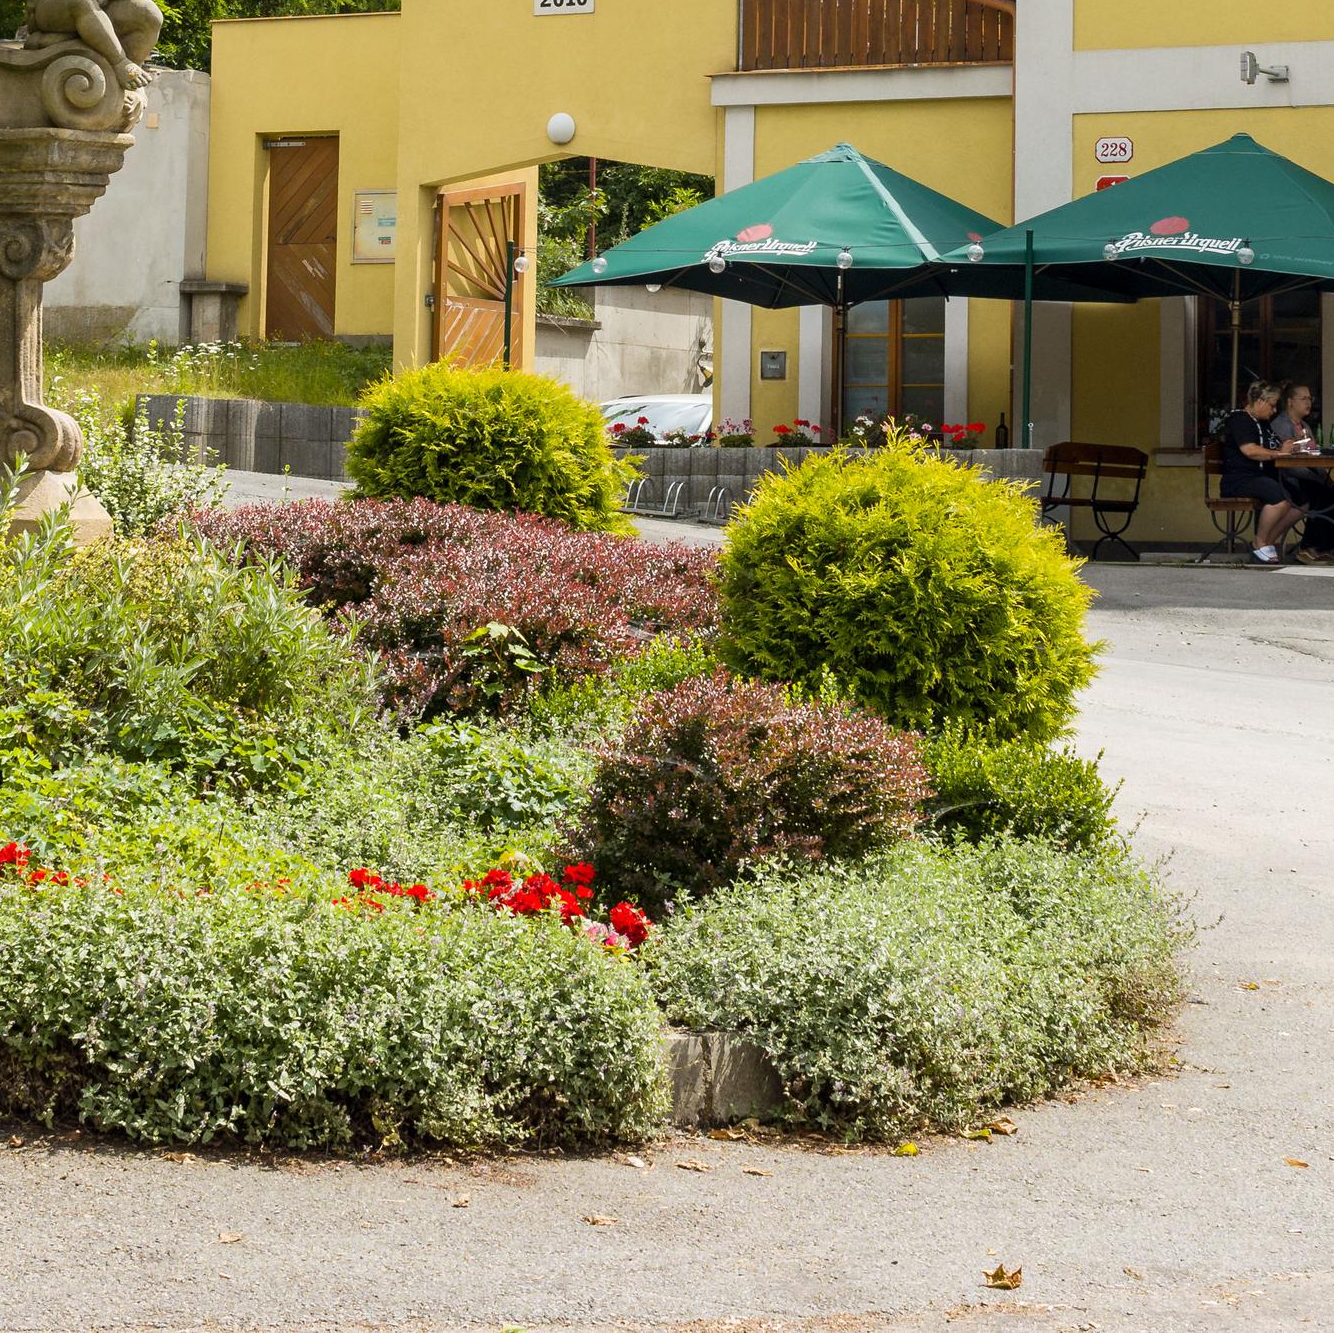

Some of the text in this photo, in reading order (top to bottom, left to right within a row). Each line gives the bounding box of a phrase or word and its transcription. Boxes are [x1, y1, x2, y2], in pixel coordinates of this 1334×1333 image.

[1100, 142, 1127, 157] 228
[762, 237, 817, 255] Urquell
[1114, 232, 1243, 254] Pilsner Urquell
